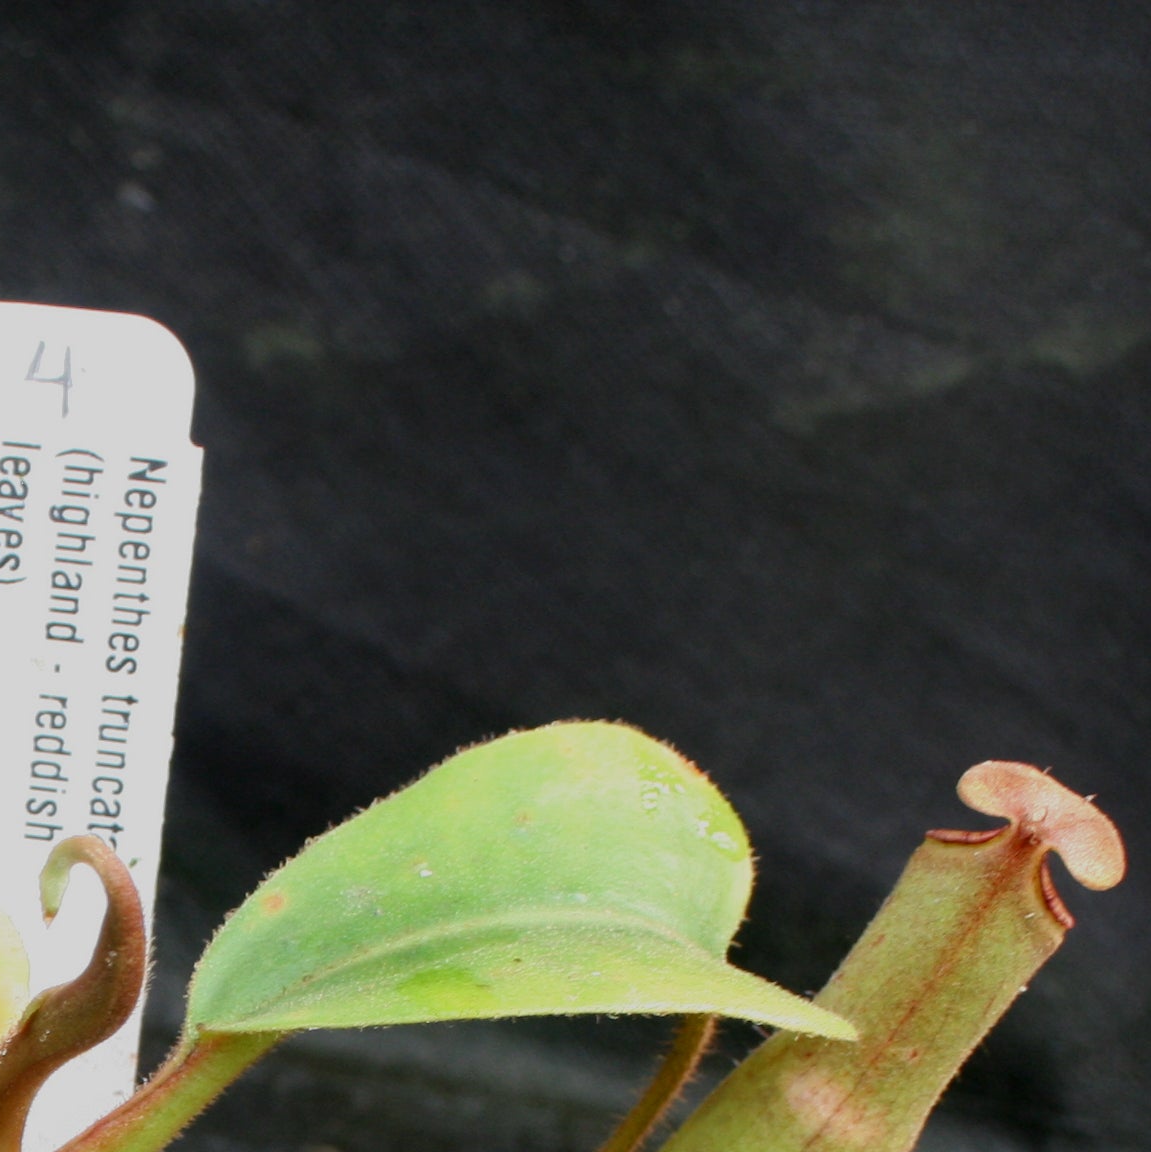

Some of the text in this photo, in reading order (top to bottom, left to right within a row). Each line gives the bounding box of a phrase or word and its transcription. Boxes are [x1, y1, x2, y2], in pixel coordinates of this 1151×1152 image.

[25, 341, 72, 418] 4
[24, 448, 104, 842] (highland - reddish
[105, 456, 168, 675] Nepenthes
